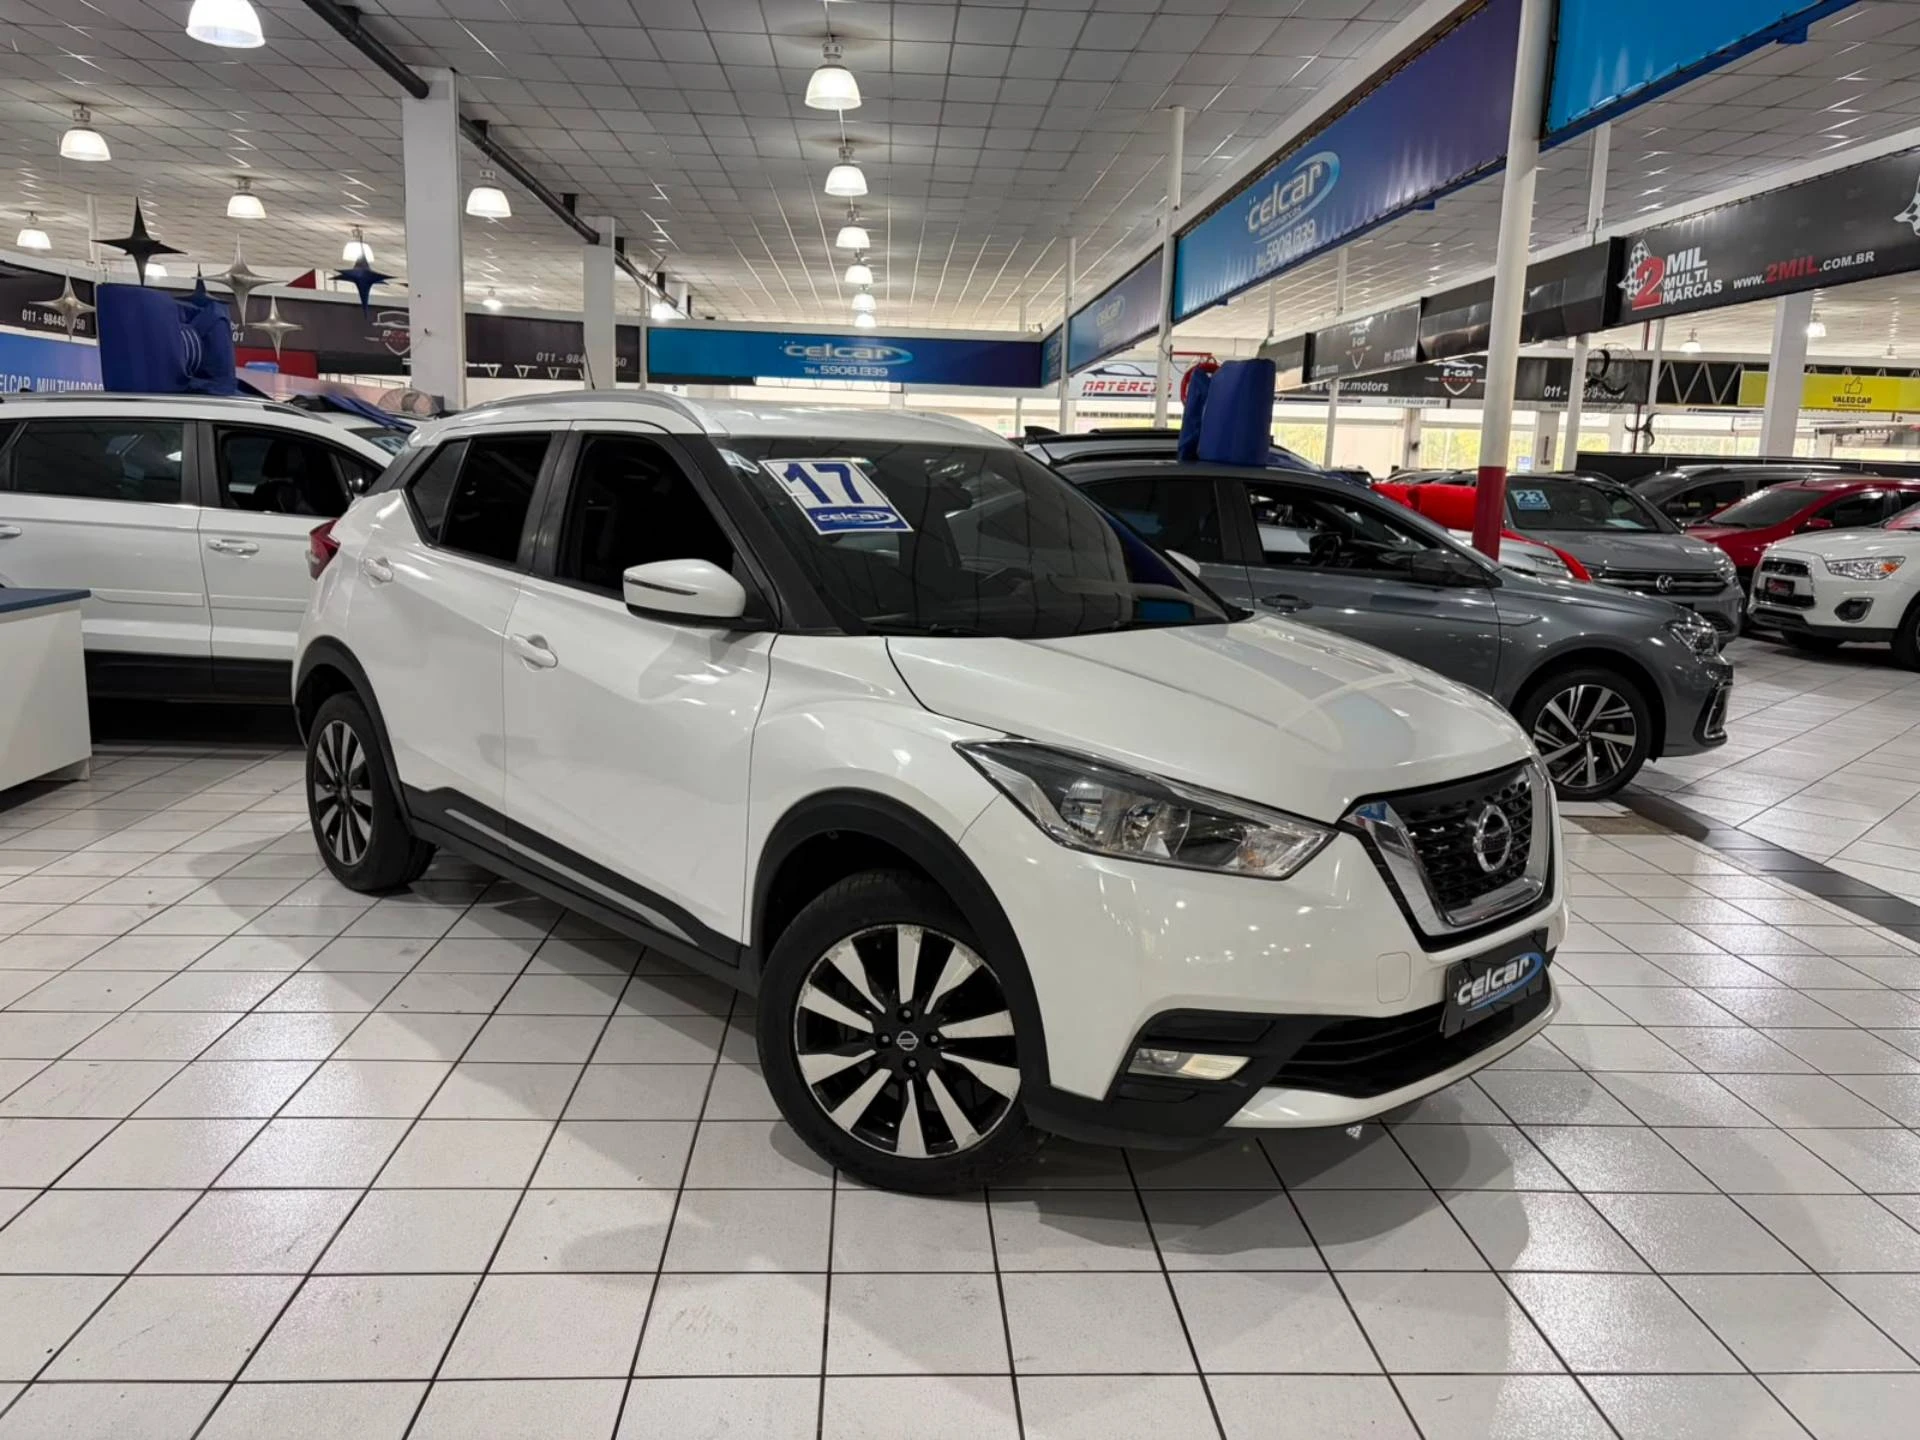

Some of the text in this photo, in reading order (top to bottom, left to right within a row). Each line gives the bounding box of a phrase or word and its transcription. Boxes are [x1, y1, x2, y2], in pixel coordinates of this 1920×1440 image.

[1248, 162, 1323, 232] celcar
[1632, 247, 1708, 310] 2 MIL
[1664, 269, 1709, 291] MULTI
[1662, 280, 1723, 304] MARCAS
[22, 309, 36, 322] 011
[43, 312, 86, 330] 9844550
[536, 352, 556, 363] 011
[785, 343, 893, 360] celcar
[1082, 378, 1172, 392] NATÉRCI
[1326, 380, 1389, 393] ear.motors
[1544, 385, 1561, 397] 011
[783, 463, 865, 504] 17
[1517, 491, 1543, 504] 23
[817, 512, 886, 523] celcar
[1457, 956, 1530, 1006] celcar
